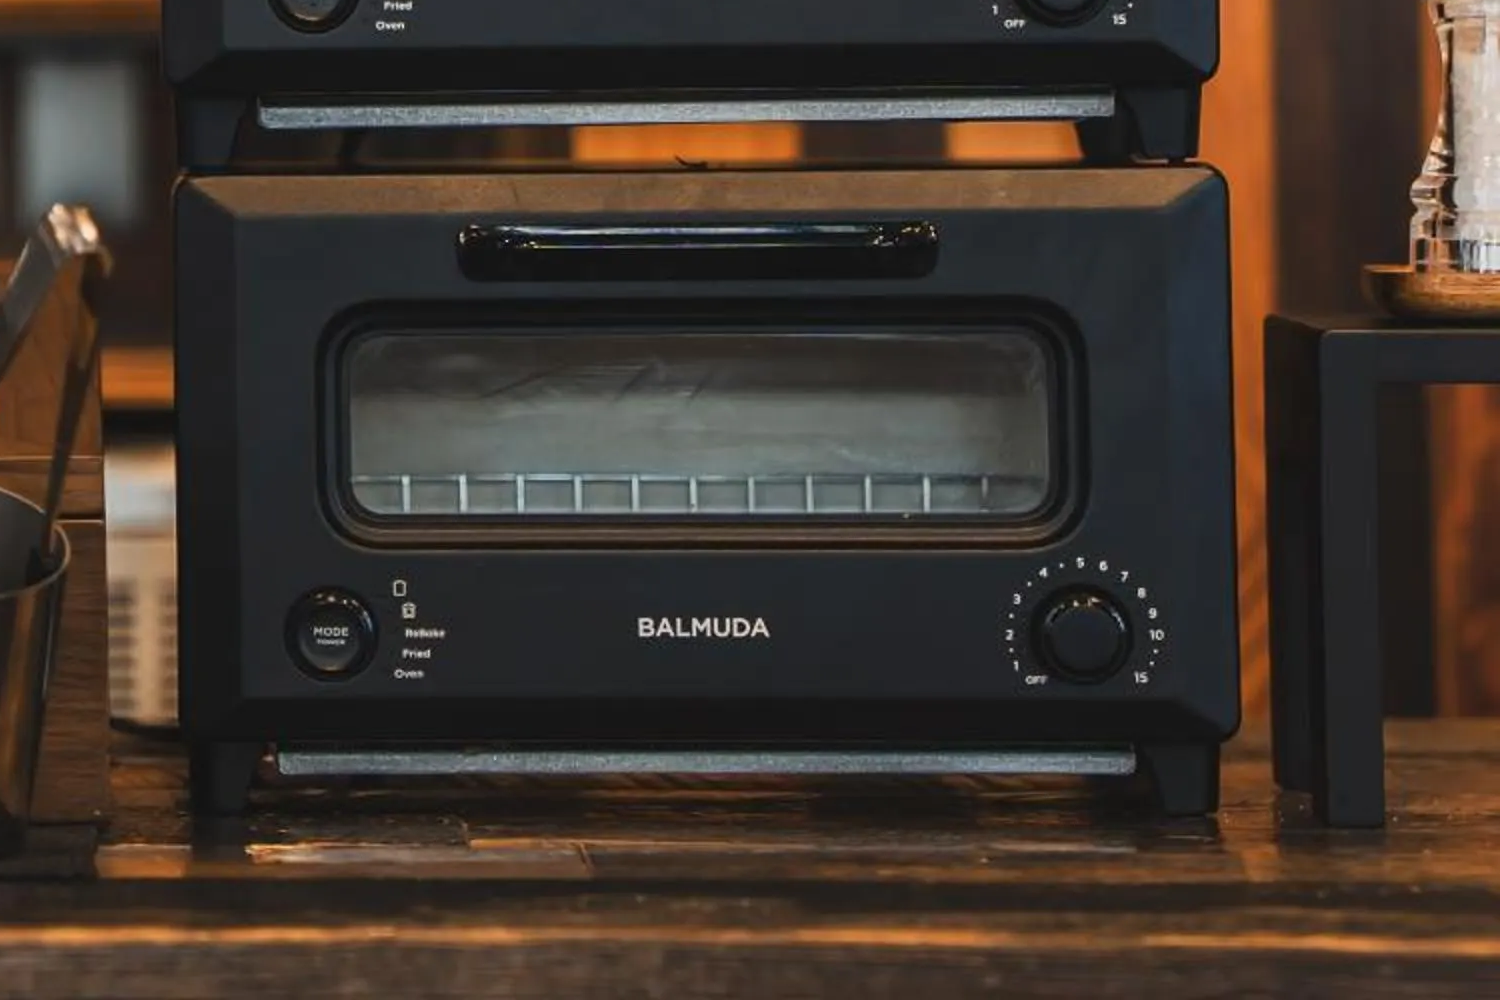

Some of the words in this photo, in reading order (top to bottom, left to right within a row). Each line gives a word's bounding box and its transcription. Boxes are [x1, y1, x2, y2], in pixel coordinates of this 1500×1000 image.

[383, 0, 413, 11] Fried
[991, 4, 999, 16] 1
[1112, 13, 1128, 26] 15
[1075, 556, 1085, 569] 5
[1099, 560, 1109, 572] 6
[1038, 567, 1048, 578] 4
[1120, 570, 1129, 583] 7
[1013, 593, 1022, 605] 3
[1137, 587, 1147, 599] 8
[1148, 607, 1158, 619] 9
[313, 626, 349, 637] MODE
[638, 617, 770, 638] BALMUDA
[1005, 628, 1014, 641] 2
[1149, 628, 1165, 641] 10
[401, 648, 431, 659] Fried
[1013, 660, 1019, 672] 1
[1133, 671, 1150, 685] 15
